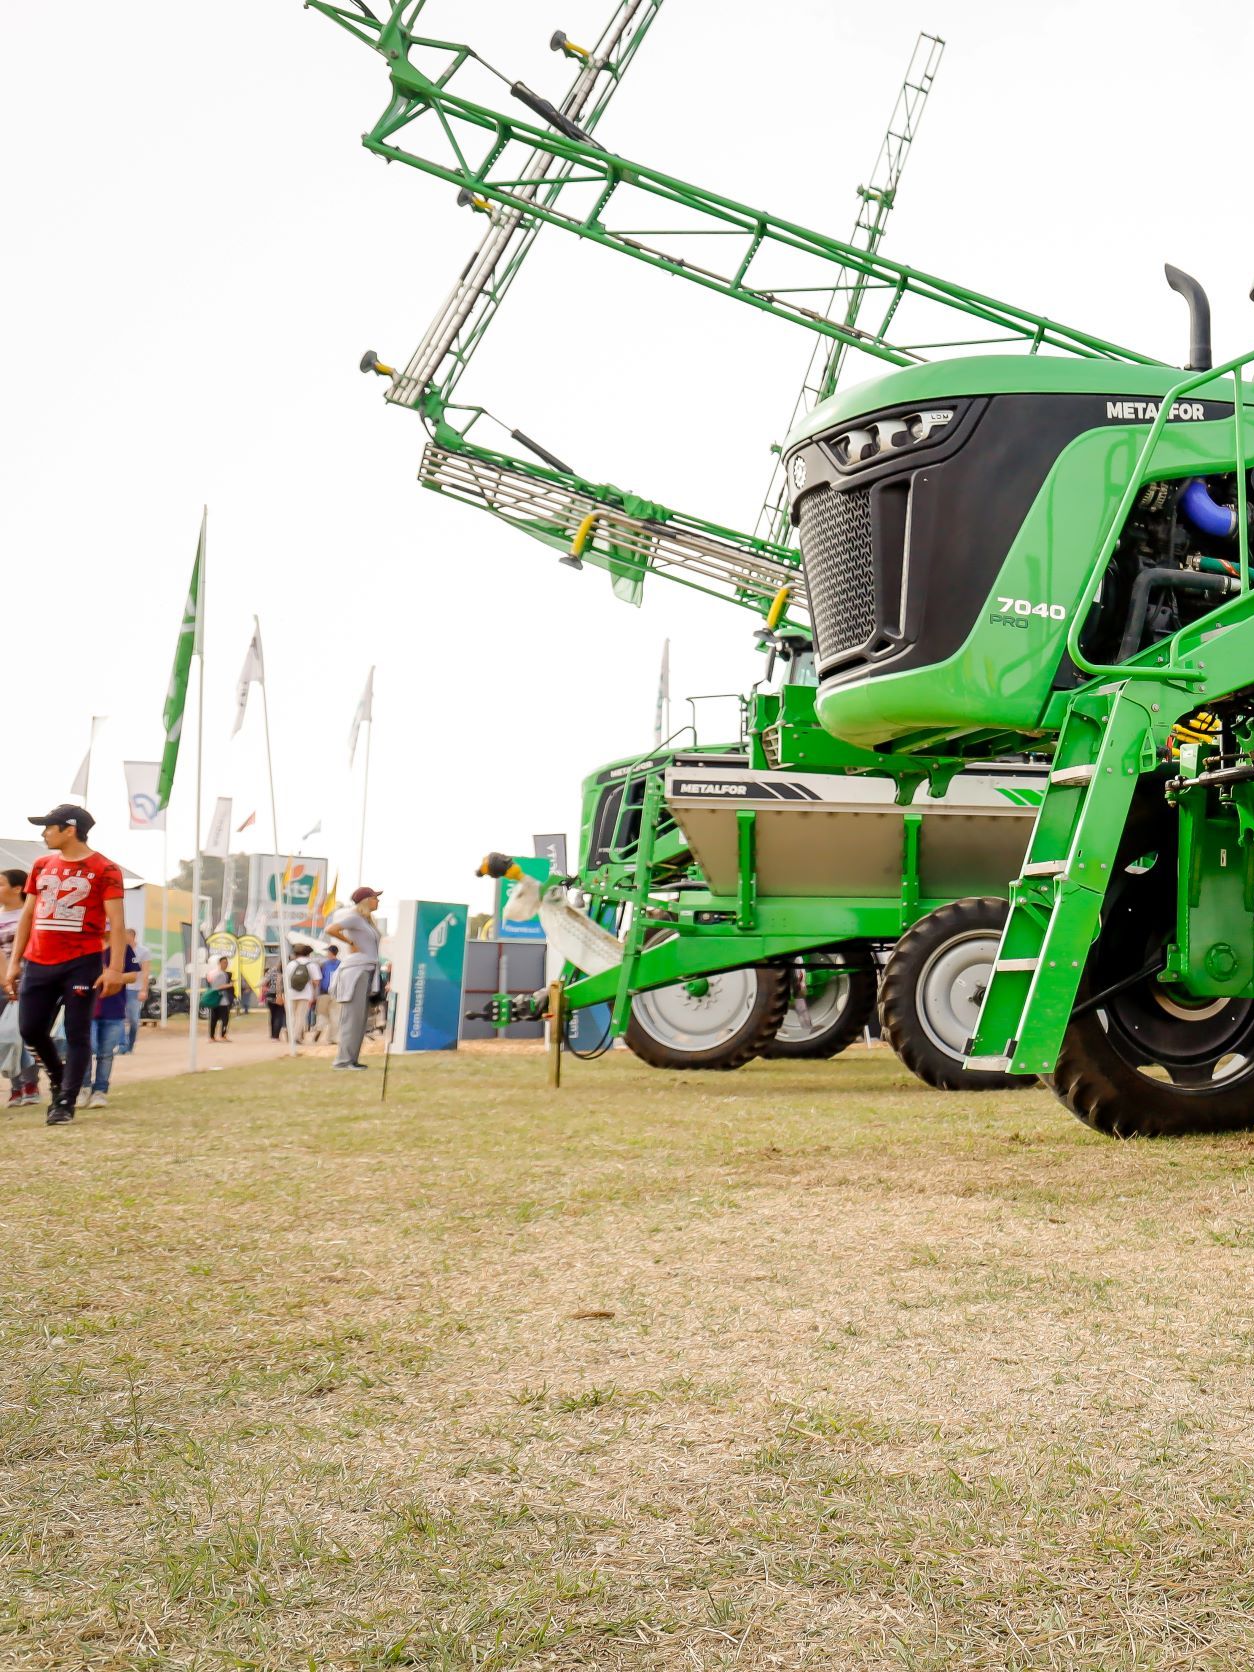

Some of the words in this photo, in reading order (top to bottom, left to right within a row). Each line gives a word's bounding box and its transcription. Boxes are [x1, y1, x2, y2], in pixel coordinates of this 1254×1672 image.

[1106, 401, 1205, 420] METAFOR
[997, 596, 1066, 620] 7040
[989, 613, 1029, 629] PRO
[680, 783, 748, 795] METALFOR
[35, 874, 92, 920] 32
[410, 962, 427, 1039] Combustibles
